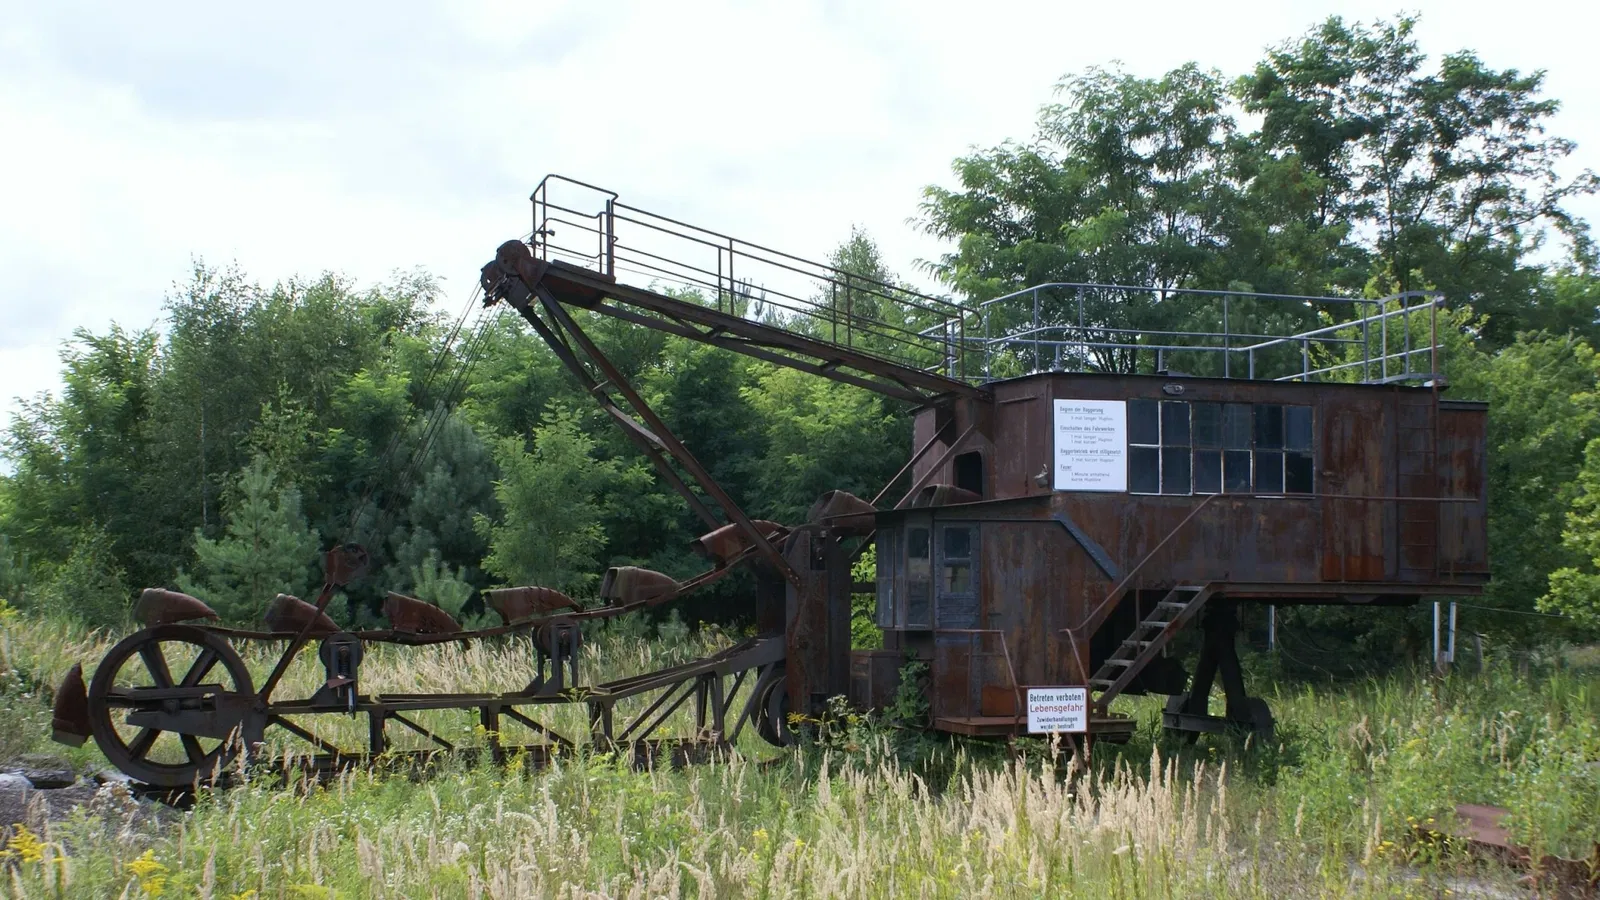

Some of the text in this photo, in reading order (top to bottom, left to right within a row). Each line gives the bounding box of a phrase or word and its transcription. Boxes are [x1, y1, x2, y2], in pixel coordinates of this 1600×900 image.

[1030, 692, 1084, 702] Betreten verboten!
[1030, 704, 1083, 714] Lebensgefahr
